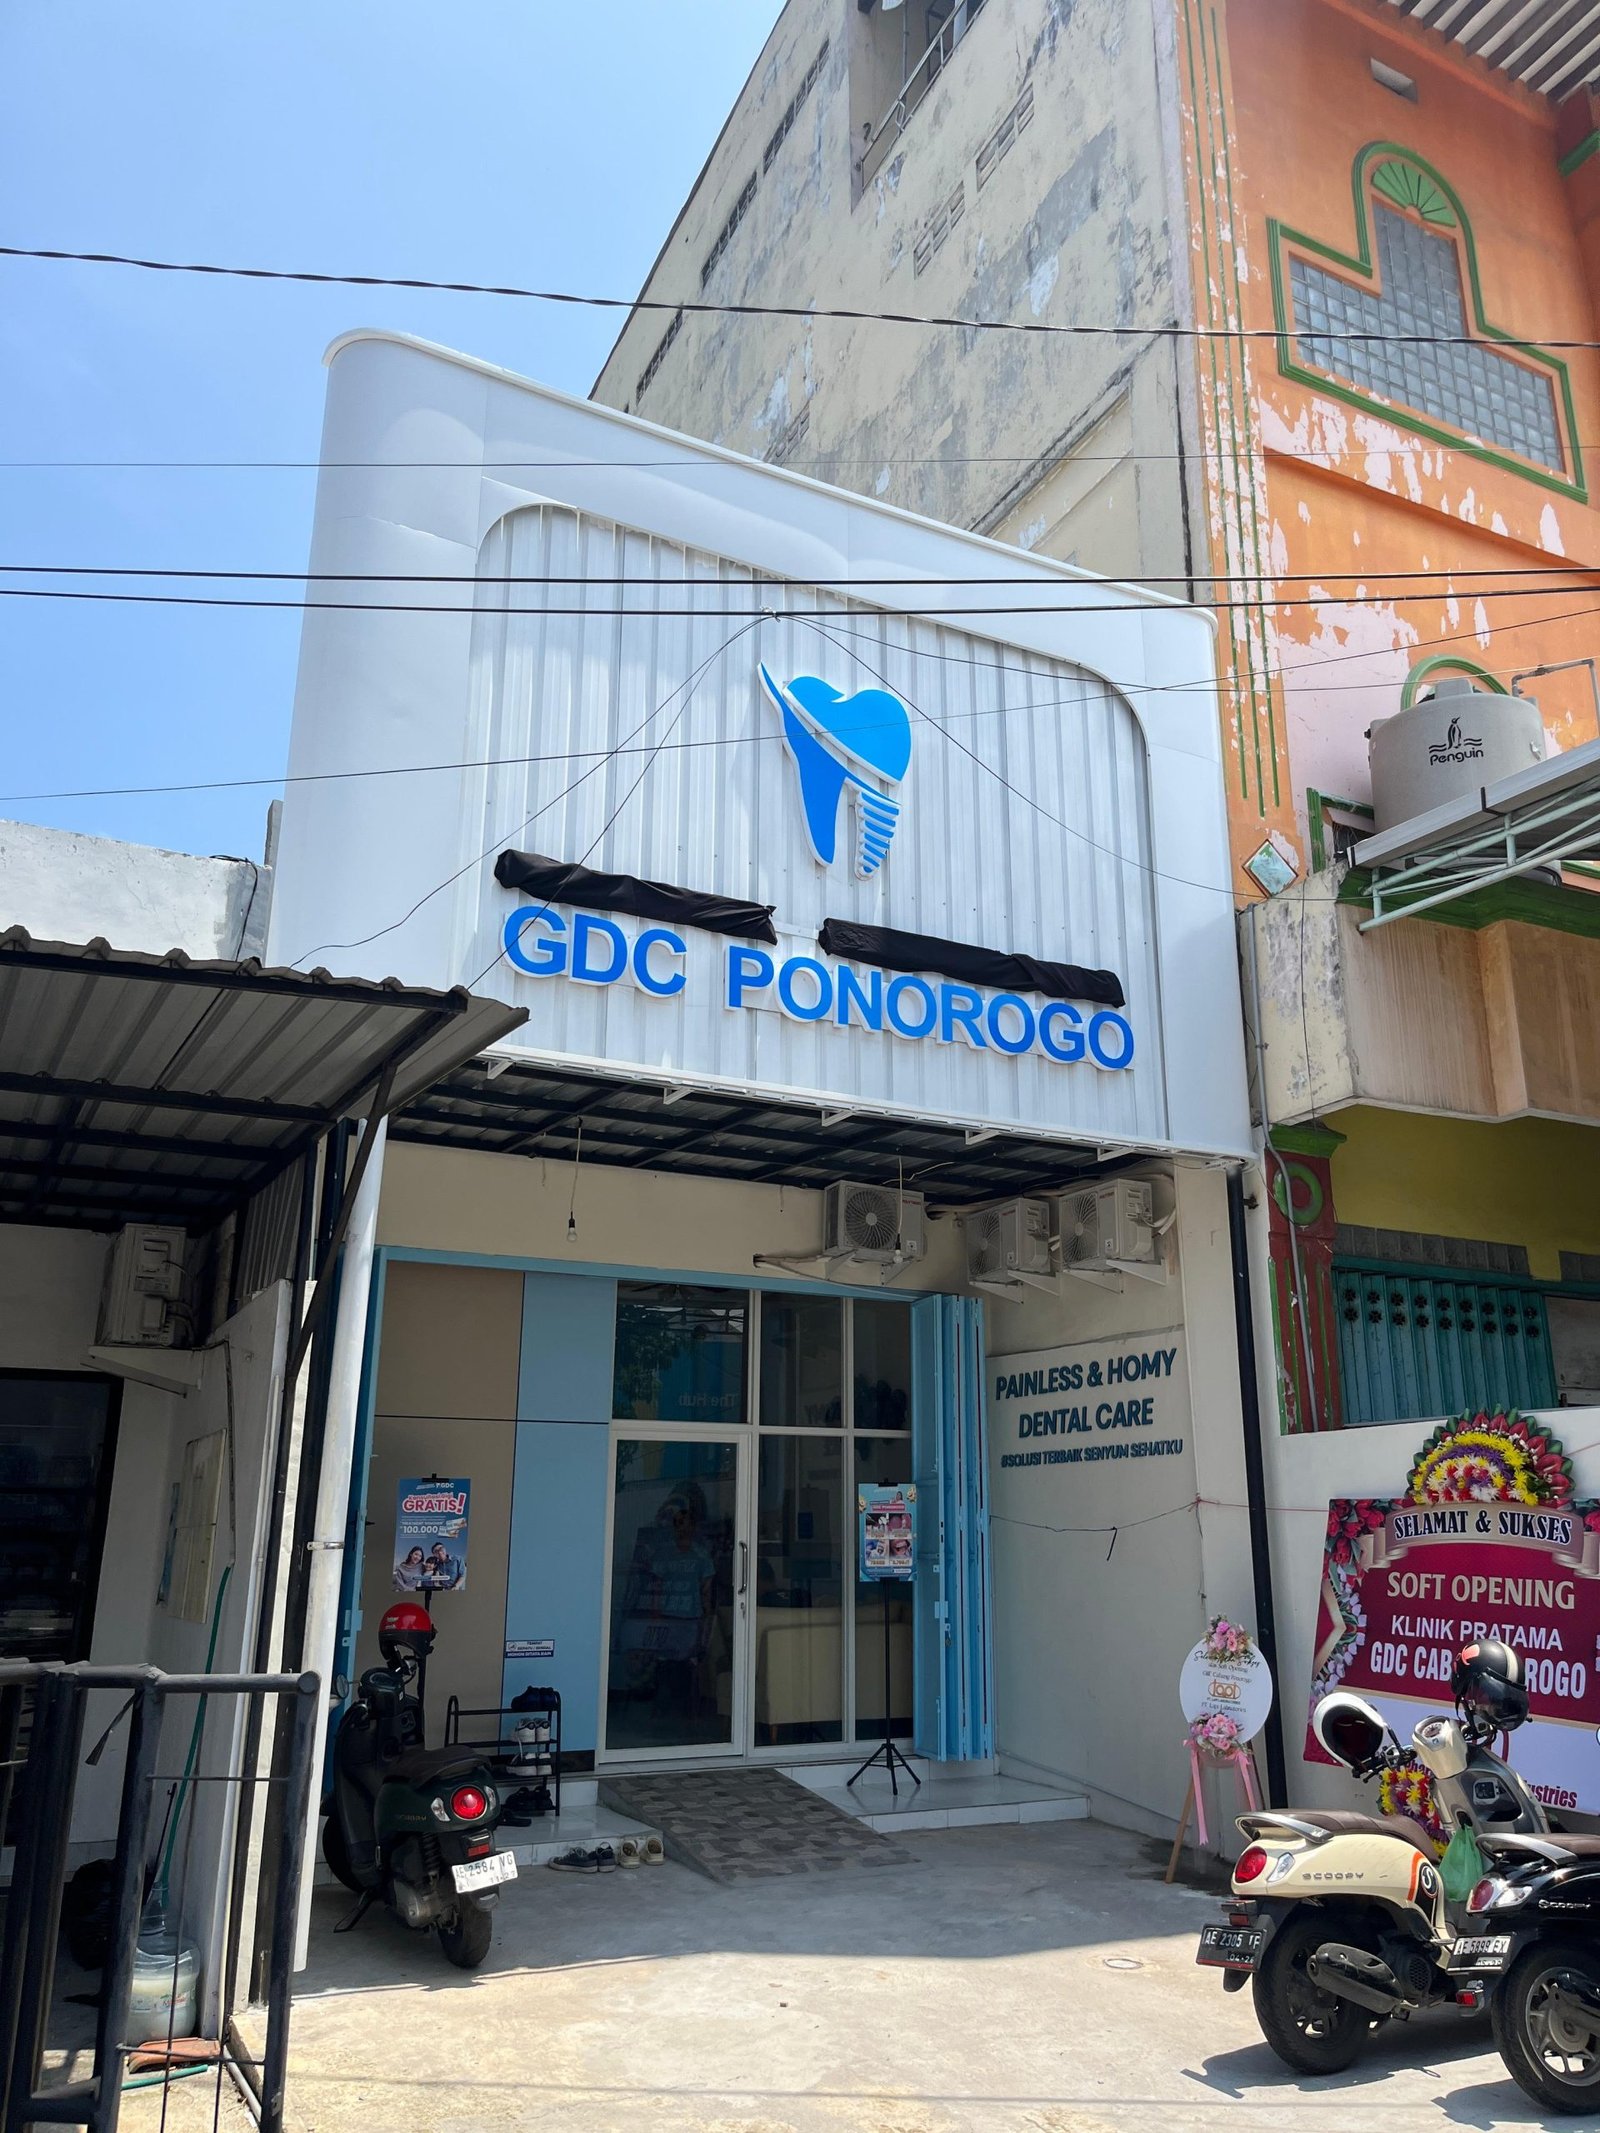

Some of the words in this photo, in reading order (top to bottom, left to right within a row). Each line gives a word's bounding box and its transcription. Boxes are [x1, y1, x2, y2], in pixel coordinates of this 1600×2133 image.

[1430, 747, 1484, 766] Penguin
[502, 904, 688, 998] GDC
[725, 944, 1135, 1071] PONOROGO
[995, 1363, 1083, 1400] PAINLESS
[1087, 1360, 1103, 1387] &
[1107, 1348, 1177, 1385] HOMY
[1019, 1405, 1092, 1438] DENTAL
[1095, 1398, 1154, 1428] CARE
[1043, 1448, 1083, 1465] TERBAIK
[1084, 1444, 1129, 1461] SENYUM
[1130, 1439, 1183, 1458] SEHATKU
[403, 1525, 438, 1533] 100.000
[1395, 1510, 1468, 1539] SELAMAT
[1475, 1510, 1491, 1533] &
[1499, 1511, 1571, 1544] SUKSES
[1387, 1571, 1445, 1600] SOFT
[1451, 1575, 1575, 1610] OPENING
[1391, 1615, 1454, 1641] KLINIK
[1460, 1620, 1563, 1652] PRATAMA
[1370, 1641, 1408, 1676] GDC
[1205, 1931, 1217, 1944] AE
[1220, 1932, 1243, 1947] 2305
